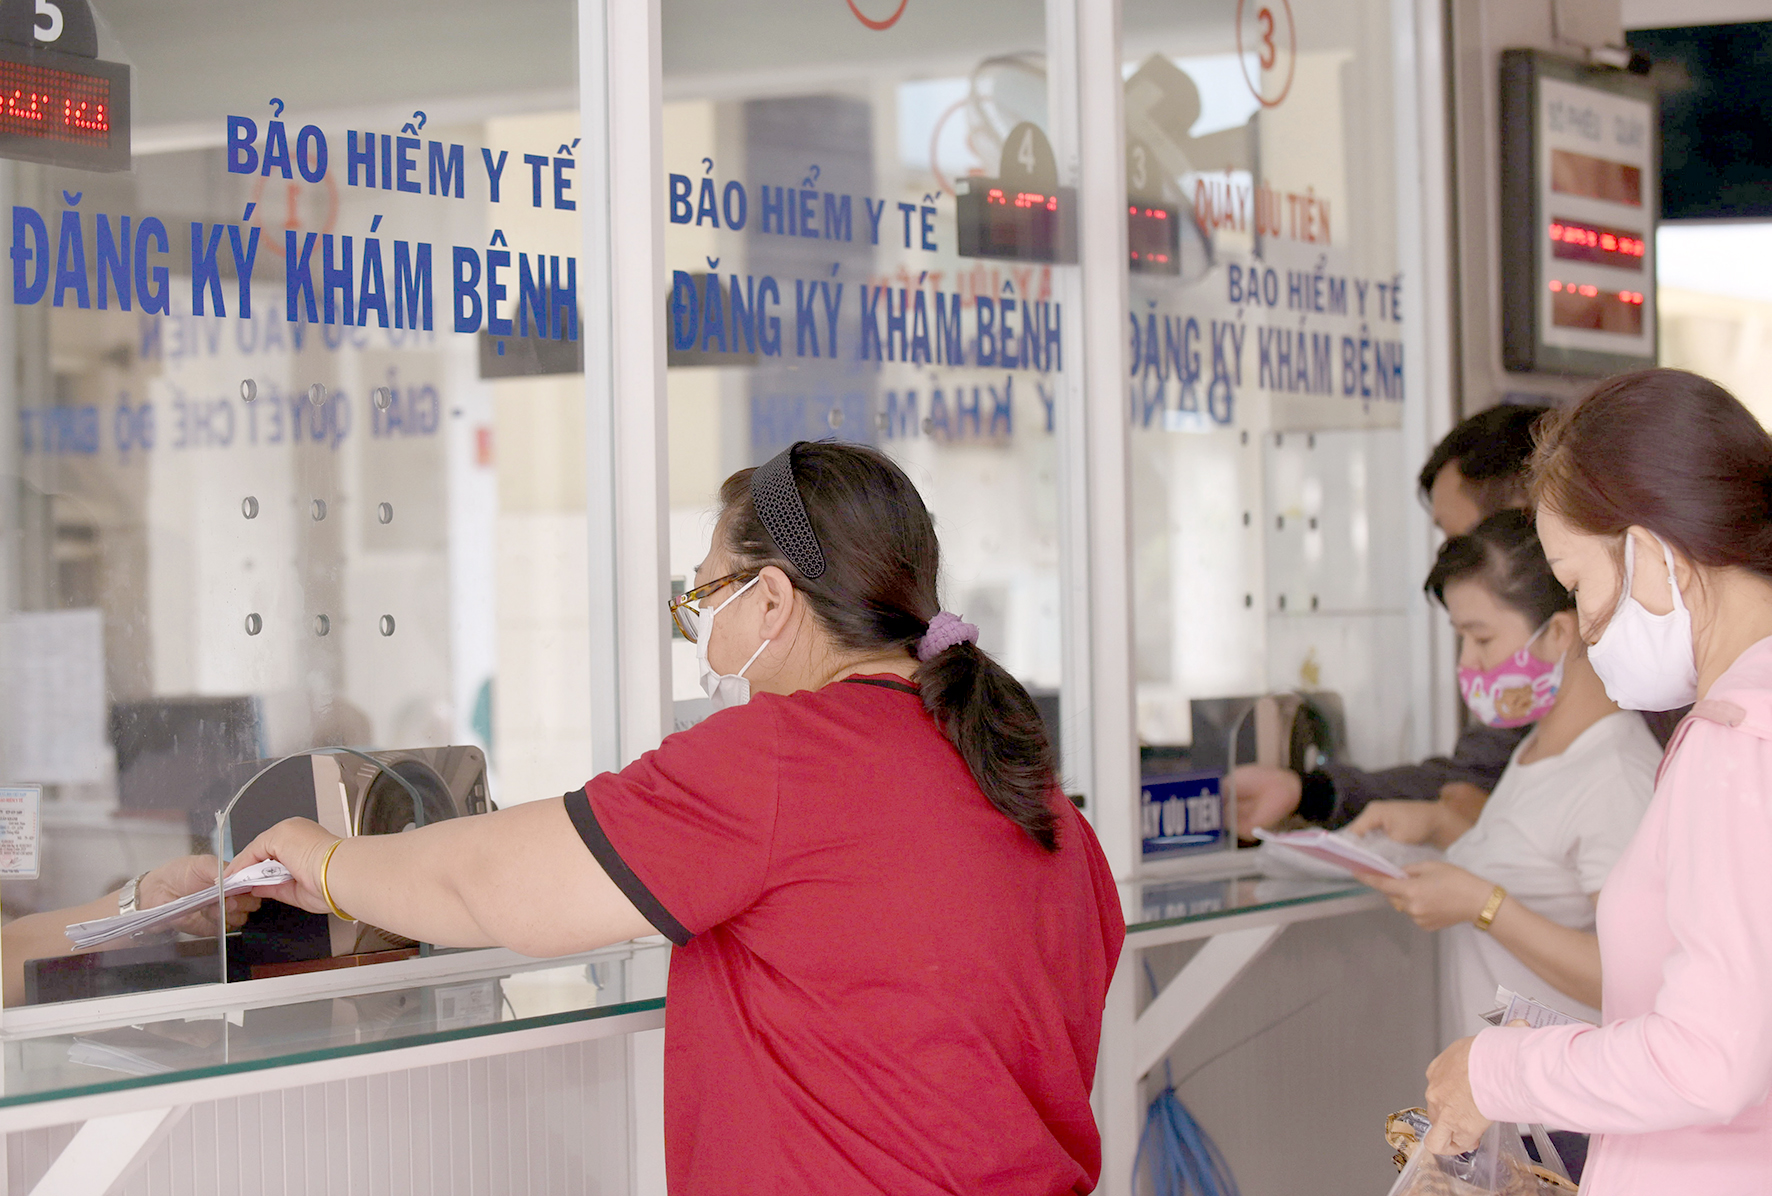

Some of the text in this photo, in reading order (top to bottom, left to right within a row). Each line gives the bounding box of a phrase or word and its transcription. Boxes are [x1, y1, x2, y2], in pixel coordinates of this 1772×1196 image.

[33, 0, 64, 42] 5
[1257, 6, 1276, 71] 3
[227, 98, 581, 211] BẢO HIỂM Y TẾ
[1016, 126, 1037, 174] 4
[1131, 147, 1146, 190] 3
[669, 158, 943, 252] BẢO HIỂM Y TẾ
[1287, 185, 1331, 245] TIÊN
[10, 190, 579, 356] ĐĂNG KÝ KHÁM BỆNH
[1229, 251, 1403, 322] BẢO HIỂM Y TẾ
[670, 256, 782, 357] ĐĂNG
[795, 262, 844, 359] KÝ
[860, 271, 965, 366] KHÁM
[1211, 309, 1246, 388] KÝ
[1258, 316, 1333, 396] KHÁM
[1342, 322, 1404, 412] BỆNH
